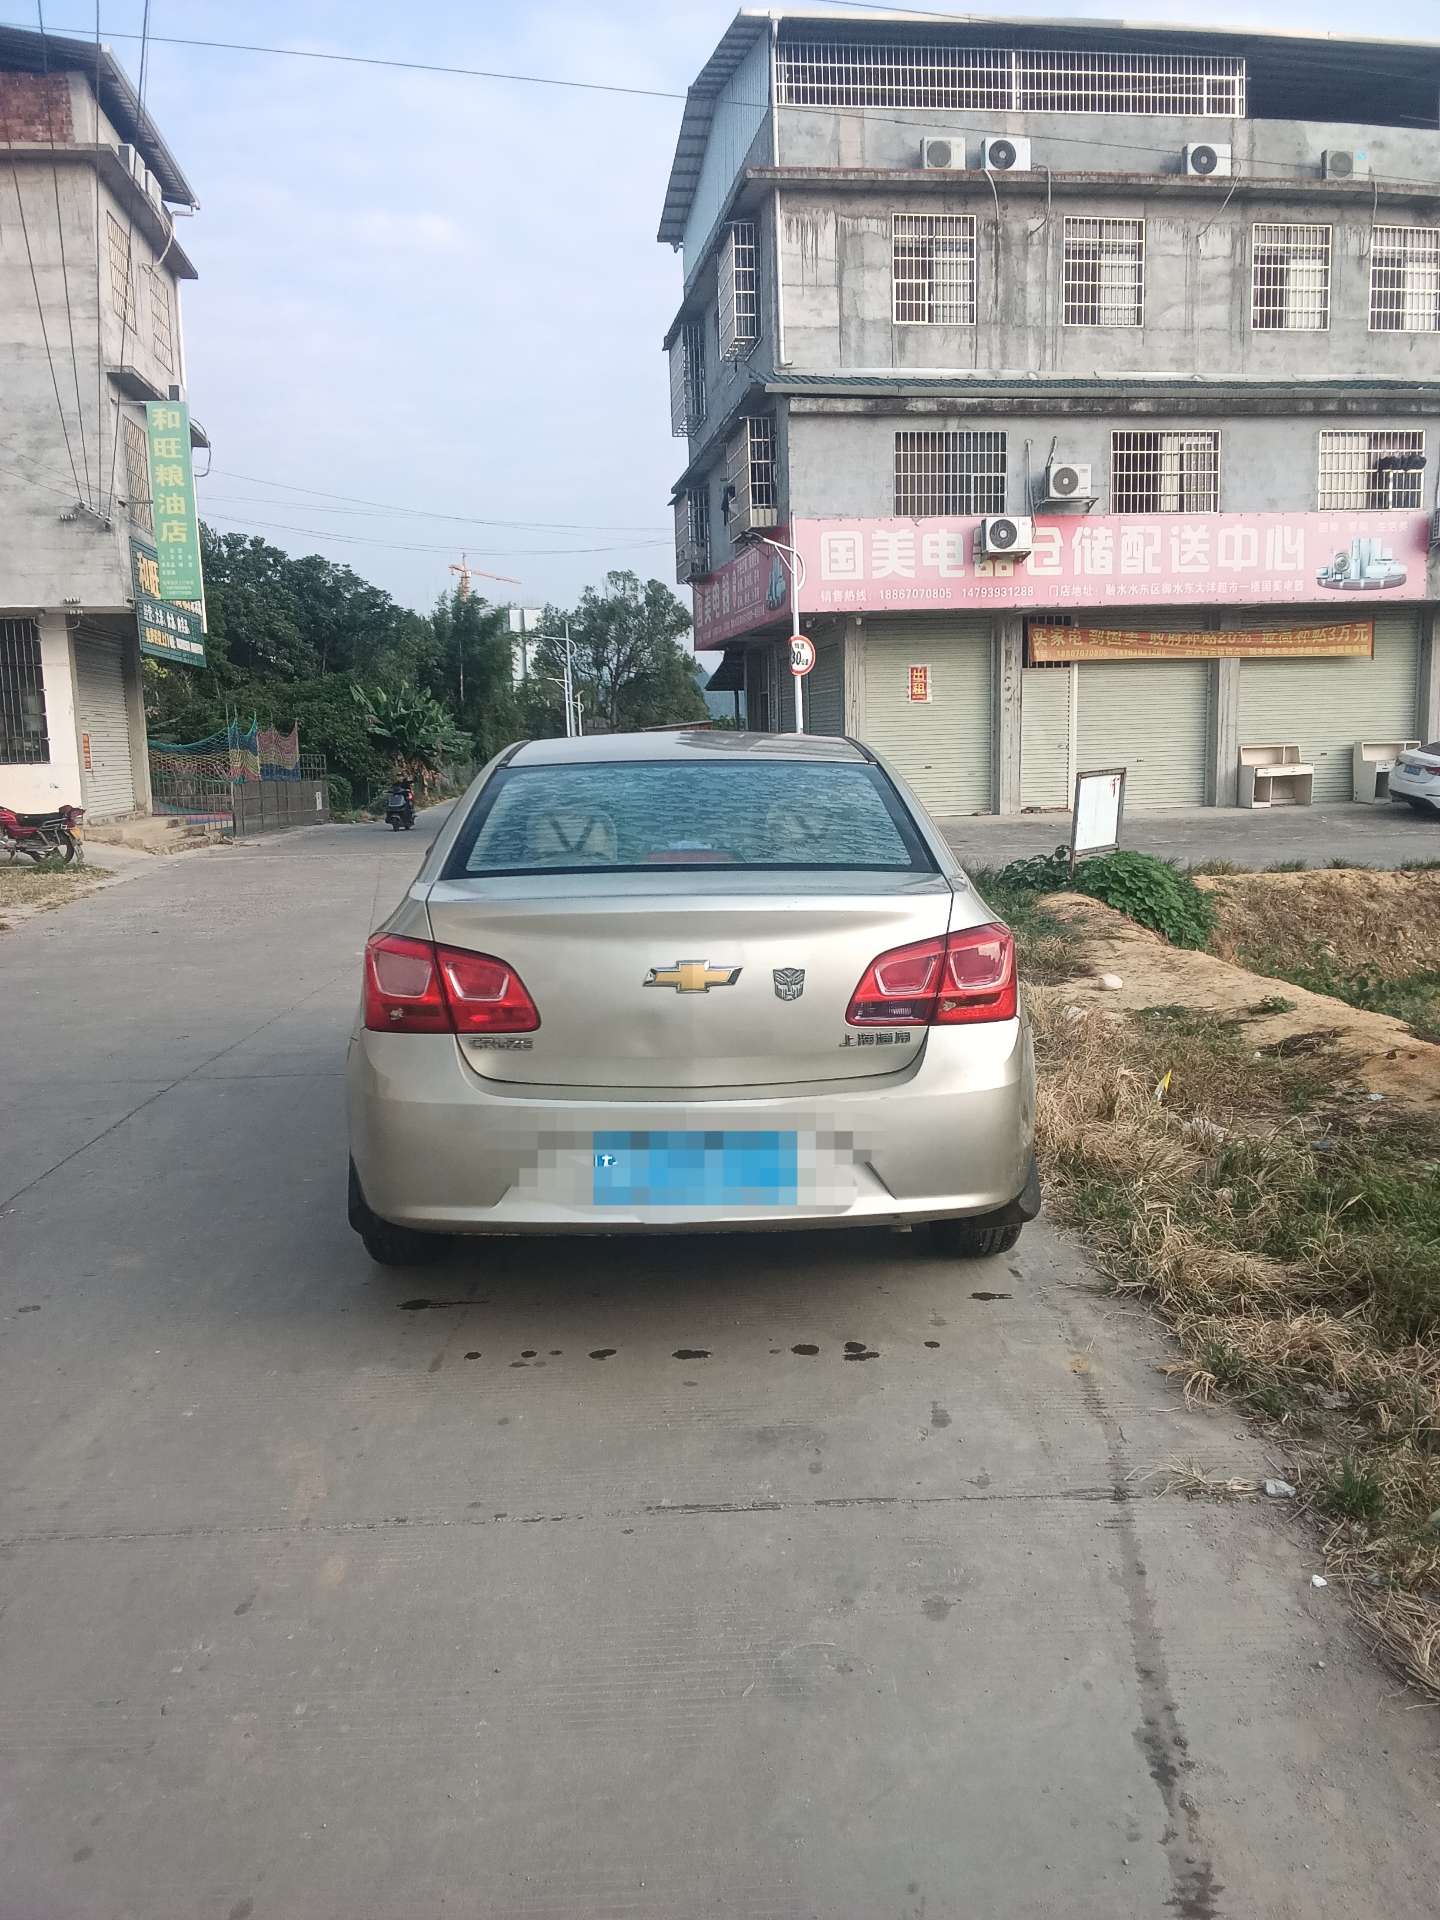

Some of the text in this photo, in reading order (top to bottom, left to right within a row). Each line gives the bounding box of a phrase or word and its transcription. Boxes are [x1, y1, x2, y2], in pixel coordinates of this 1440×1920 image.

[152, 407, 188, 544] 和旺粮油店
[1033, 627, 1082, 646] 买家电
